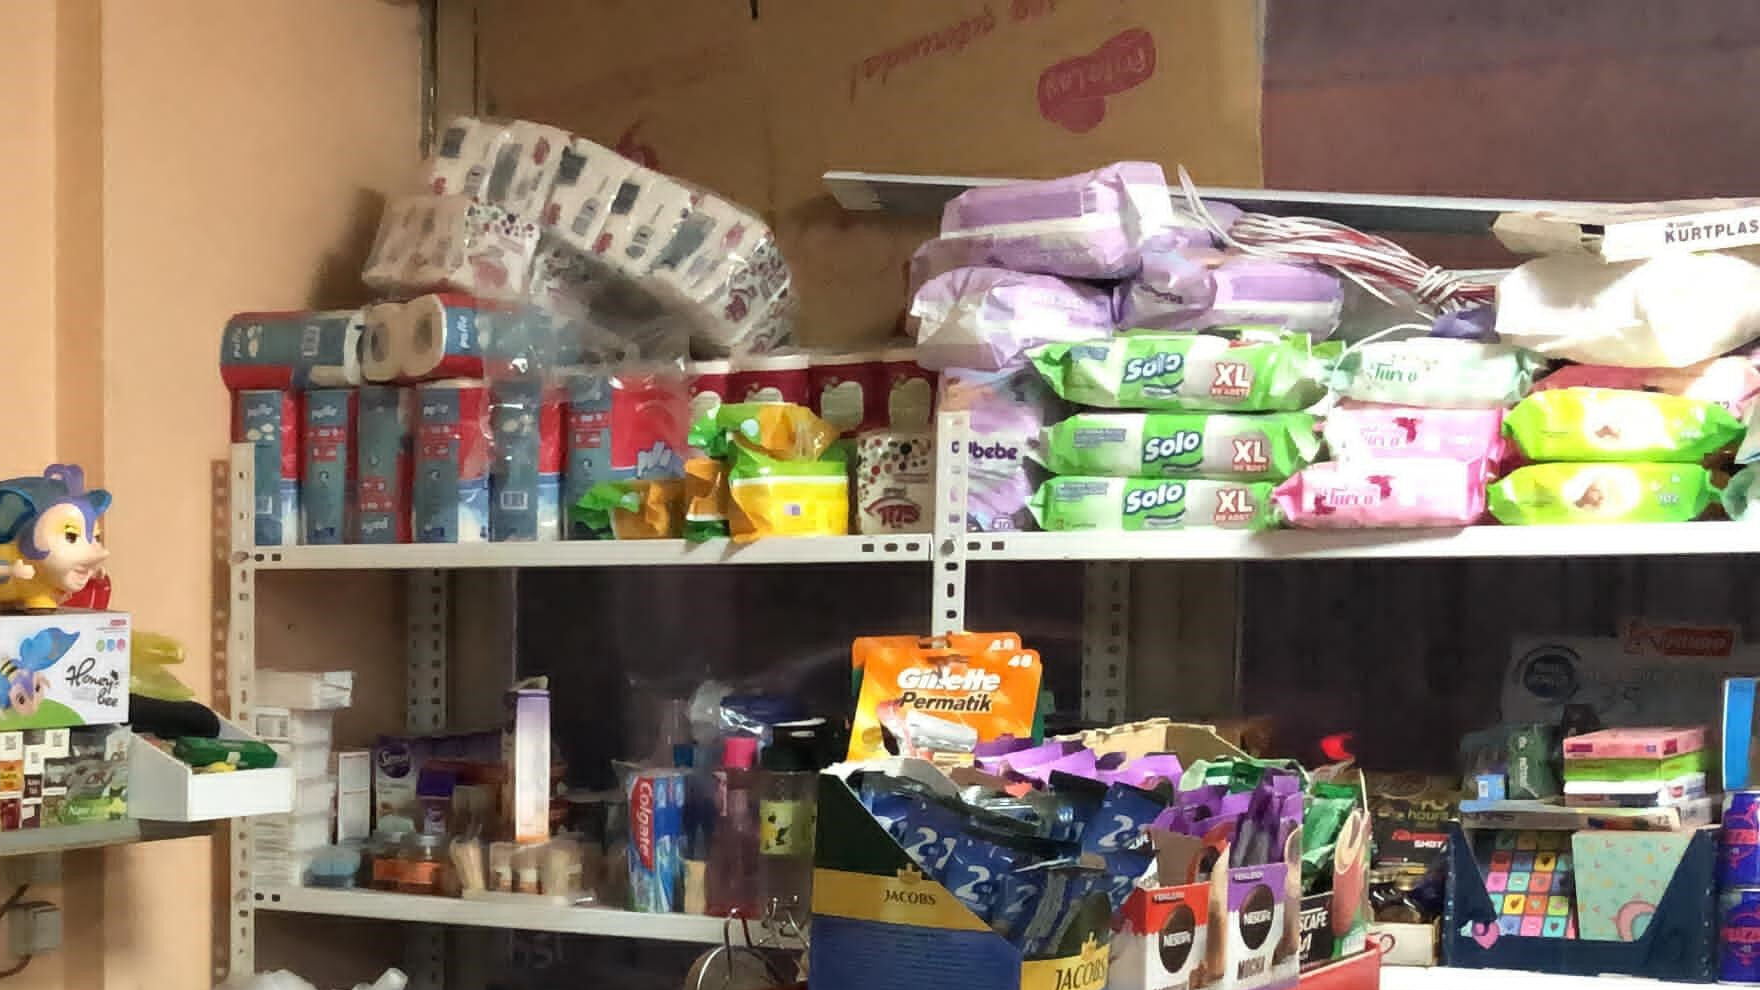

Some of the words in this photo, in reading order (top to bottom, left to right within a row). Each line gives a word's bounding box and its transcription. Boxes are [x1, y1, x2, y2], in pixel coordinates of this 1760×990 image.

[1123, 353, 1183, 384] Solo
[1215, 363, 1251, 387] XL
[1144, 431, 1199, 461] Solo
[1232, 440, 1267, 464] XL
[1124, 482, 1183, 514] Solo
[1216, 490, 1253, 514] XL
[899, 691, 993, 712] Permatik
[639, 781, 653, 858] Colgate
[881, 889, 938, 907] JACOBS
[1300, 909, 1328, 933] SCAFE
